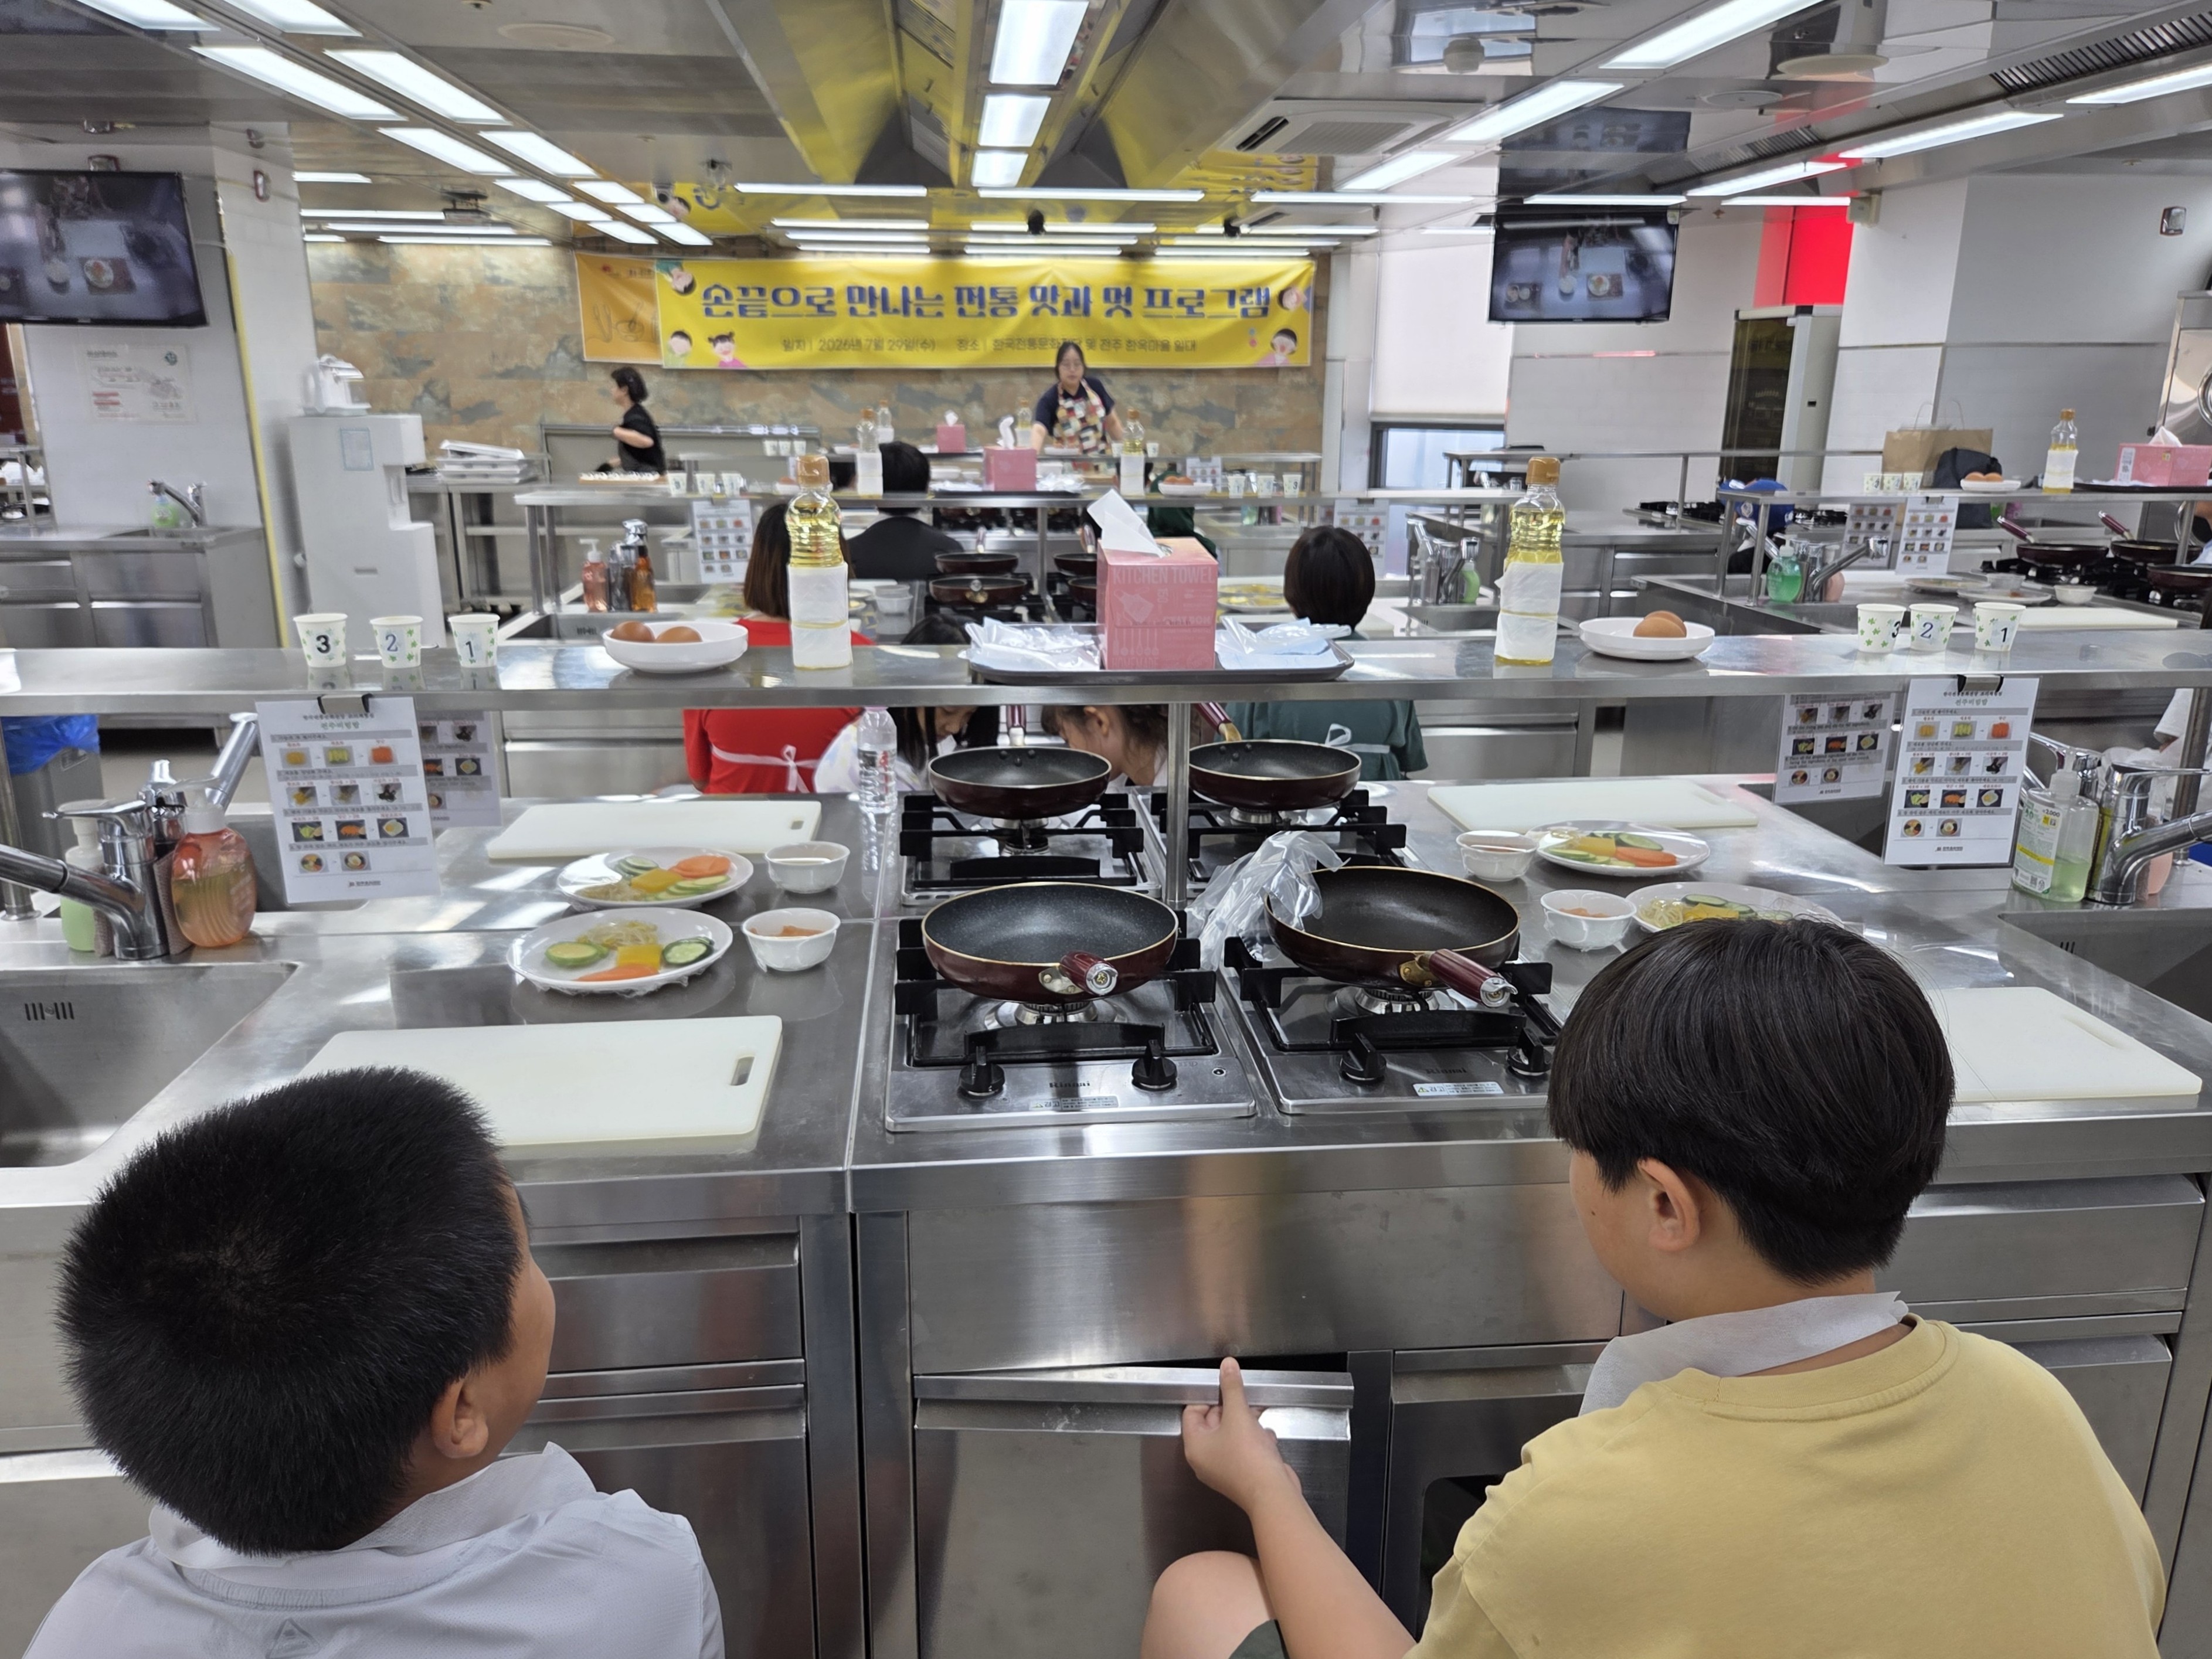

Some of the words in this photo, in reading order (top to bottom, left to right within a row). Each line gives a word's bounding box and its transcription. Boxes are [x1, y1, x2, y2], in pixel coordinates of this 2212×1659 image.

[702, 284, 837, 318] 손끝으로
[846, 285, 944, 318] 만나는
[954, 285, 1018, 318] 전통
[1029, 285, 1093, 317] 맛과
[1103, 285, 1133, 318] 멋
[1143, 287, 1271, 318] 프로그램
[1113, 566, 1168, 584] KITCHEN
[1171, 566, 1215, 584] TOWEL
[1891, 621, 1901, 638] 3
[1920, 621, 1934, 639] 2
[2000, 627, 2009, 642] 1
[315, 634, 331, 654] 3
[385, 634, 398, 652] 2
[465, 641, 474, 658] 1
[1049, 1080, 1091, 1089] Rinnai
